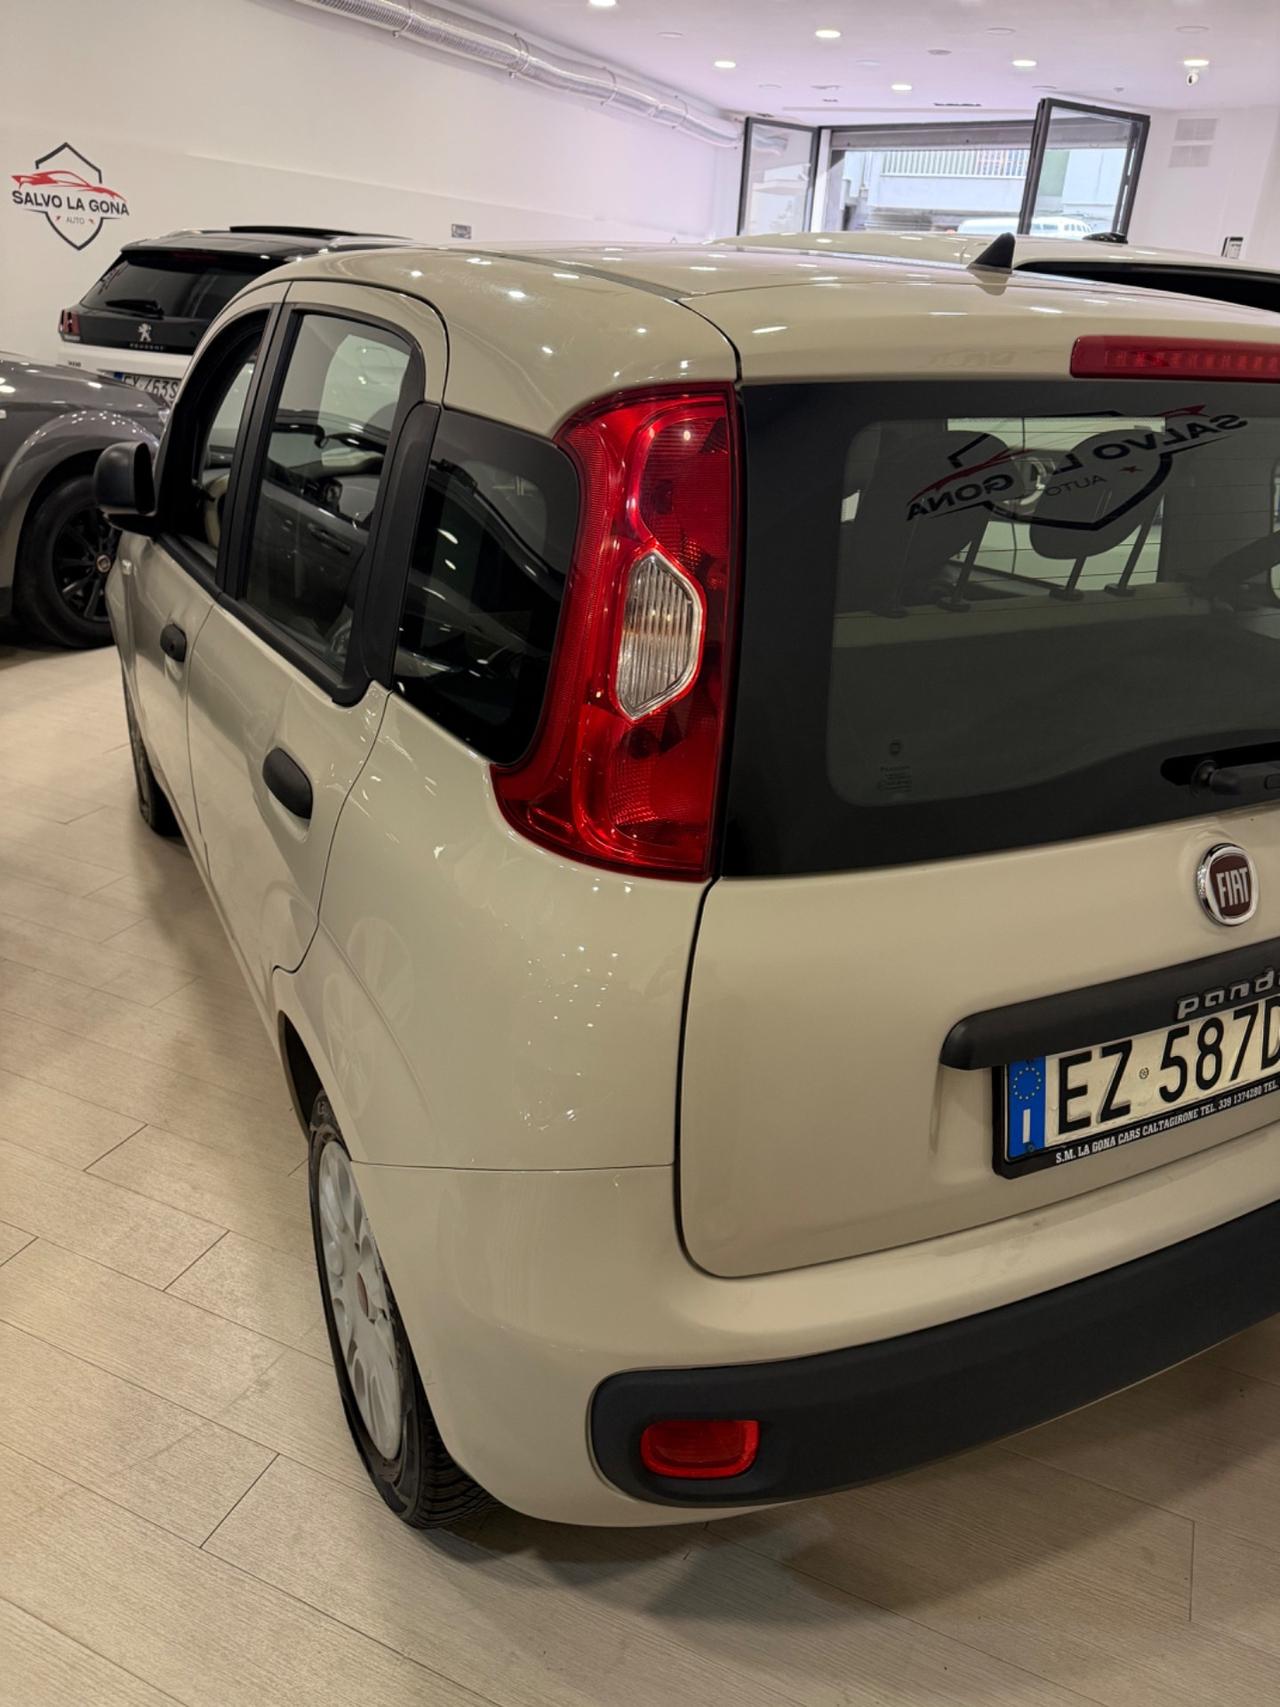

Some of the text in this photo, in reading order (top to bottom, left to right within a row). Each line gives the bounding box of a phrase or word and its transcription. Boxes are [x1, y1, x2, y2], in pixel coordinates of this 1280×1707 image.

[12, 190, 130, 216] SALVO LA GONA
[66, 215, 85, 225] AUTO
[1216, 867, 1249, 908] FIAT
[1177, 970, 1280, 1019] pand
[1058, 1039, 1133, 1135] EZ
[1056, 1148, 1077, 1163] S.M.
[1078, 1144, 1090, 1157] LA
[1092, 1137, 1116, 1152] GONA
[1118, 1128, 1141, 1145] CARS
[1142, 1108, 1199, 1136] CALTAGIRONE
[1200, 1103, 1217, 1117] TEL.
[1263, 1080, 1279, 1093] TEL.
